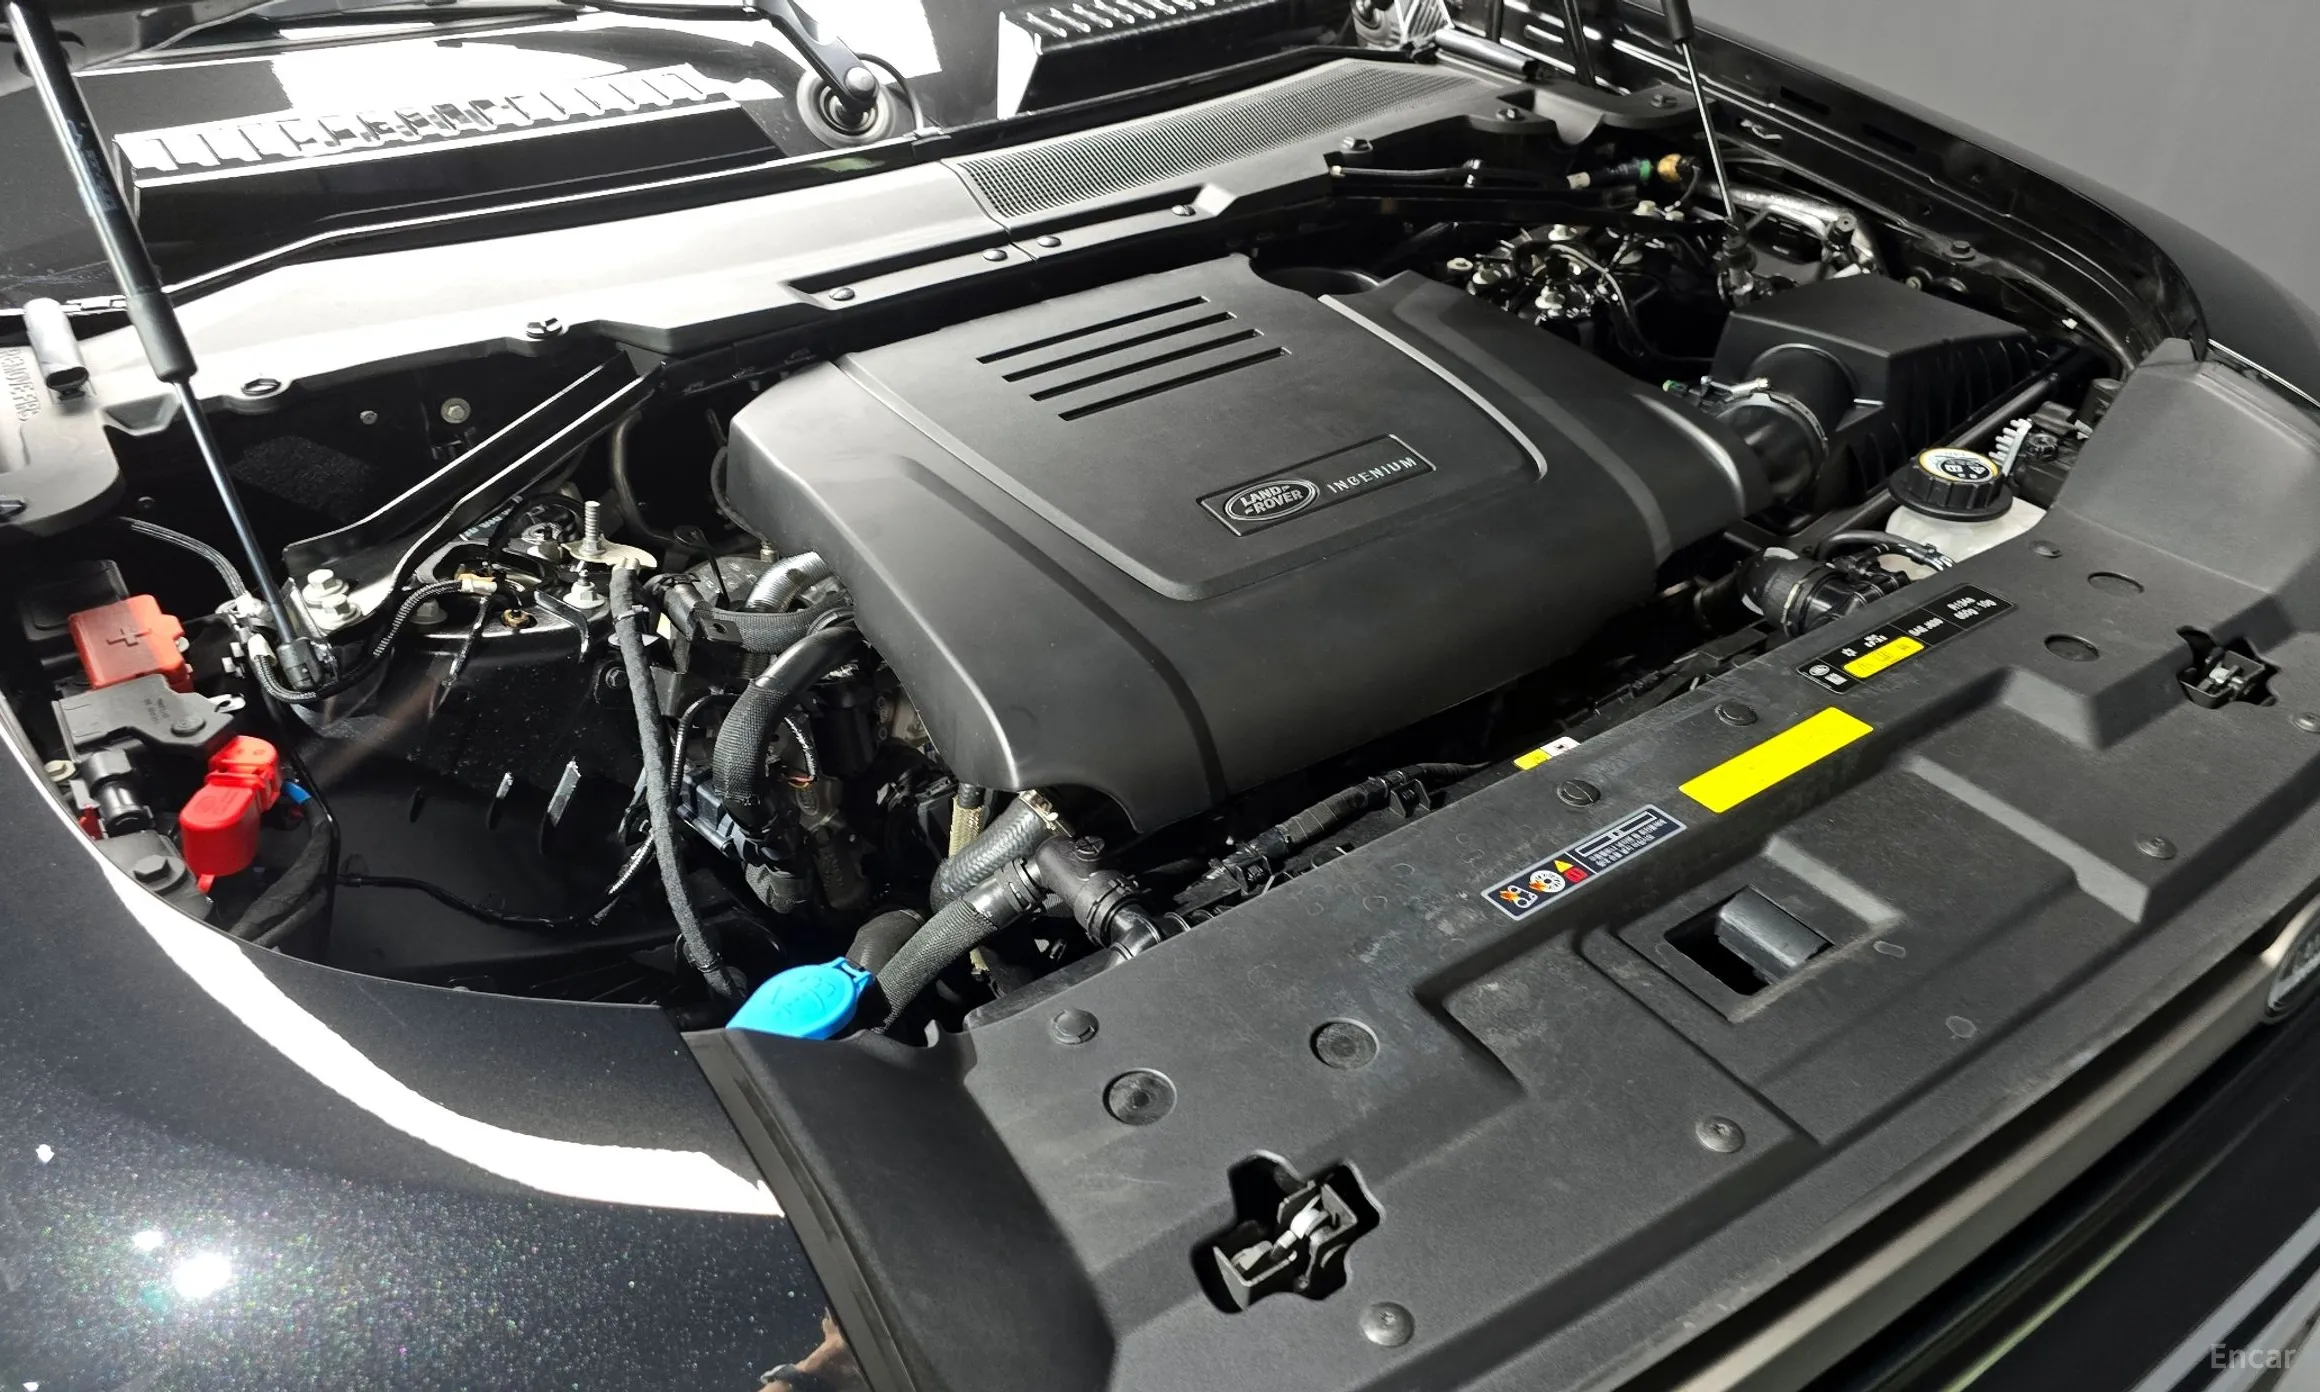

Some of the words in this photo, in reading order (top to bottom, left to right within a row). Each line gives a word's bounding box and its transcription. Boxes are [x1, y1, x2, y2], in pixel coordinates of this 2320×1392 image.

[1327, 457, 1417, 494] INGENIUM
[1240, 486, 1283, 507] LAND
[1254, 489, 1304, 514] ROVER
